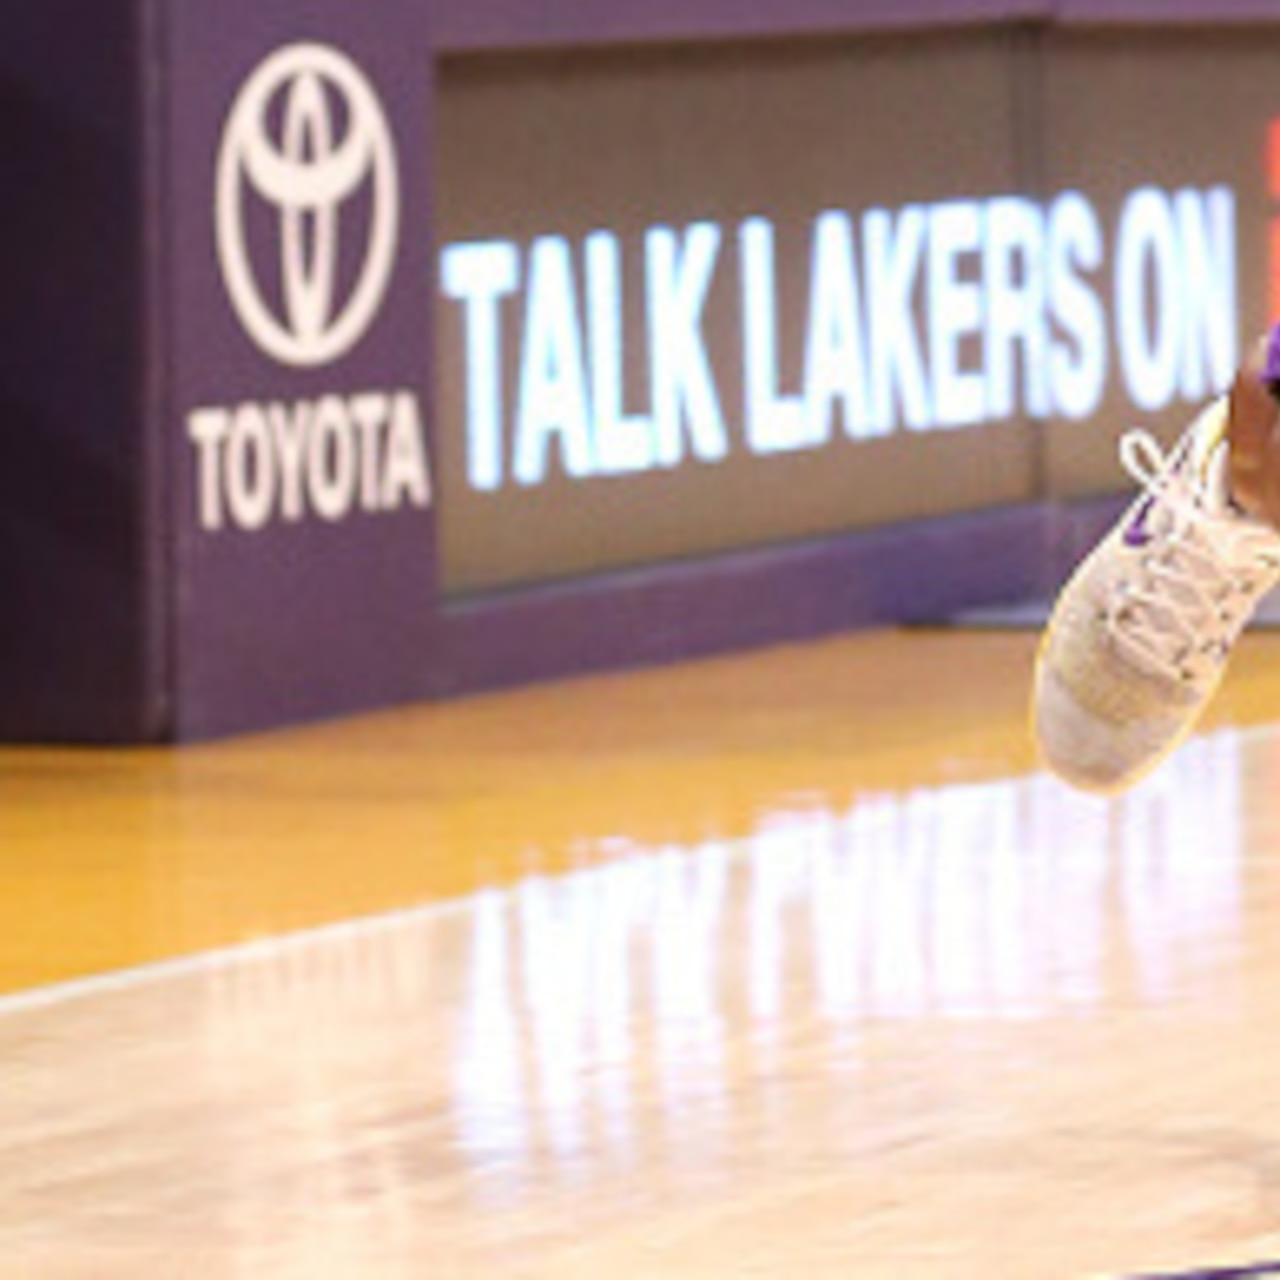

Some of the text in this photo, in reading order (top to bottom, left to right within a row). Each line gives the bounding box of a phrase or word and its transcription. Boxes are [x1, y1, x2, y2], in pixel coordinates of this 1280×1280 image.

[440, 220, 728, 491] TALK
[739, 187, 1106, 457] LAKERS
[1114, 183, 1238, 411] ON
[187, 389, 431, 531] TOYOTA
